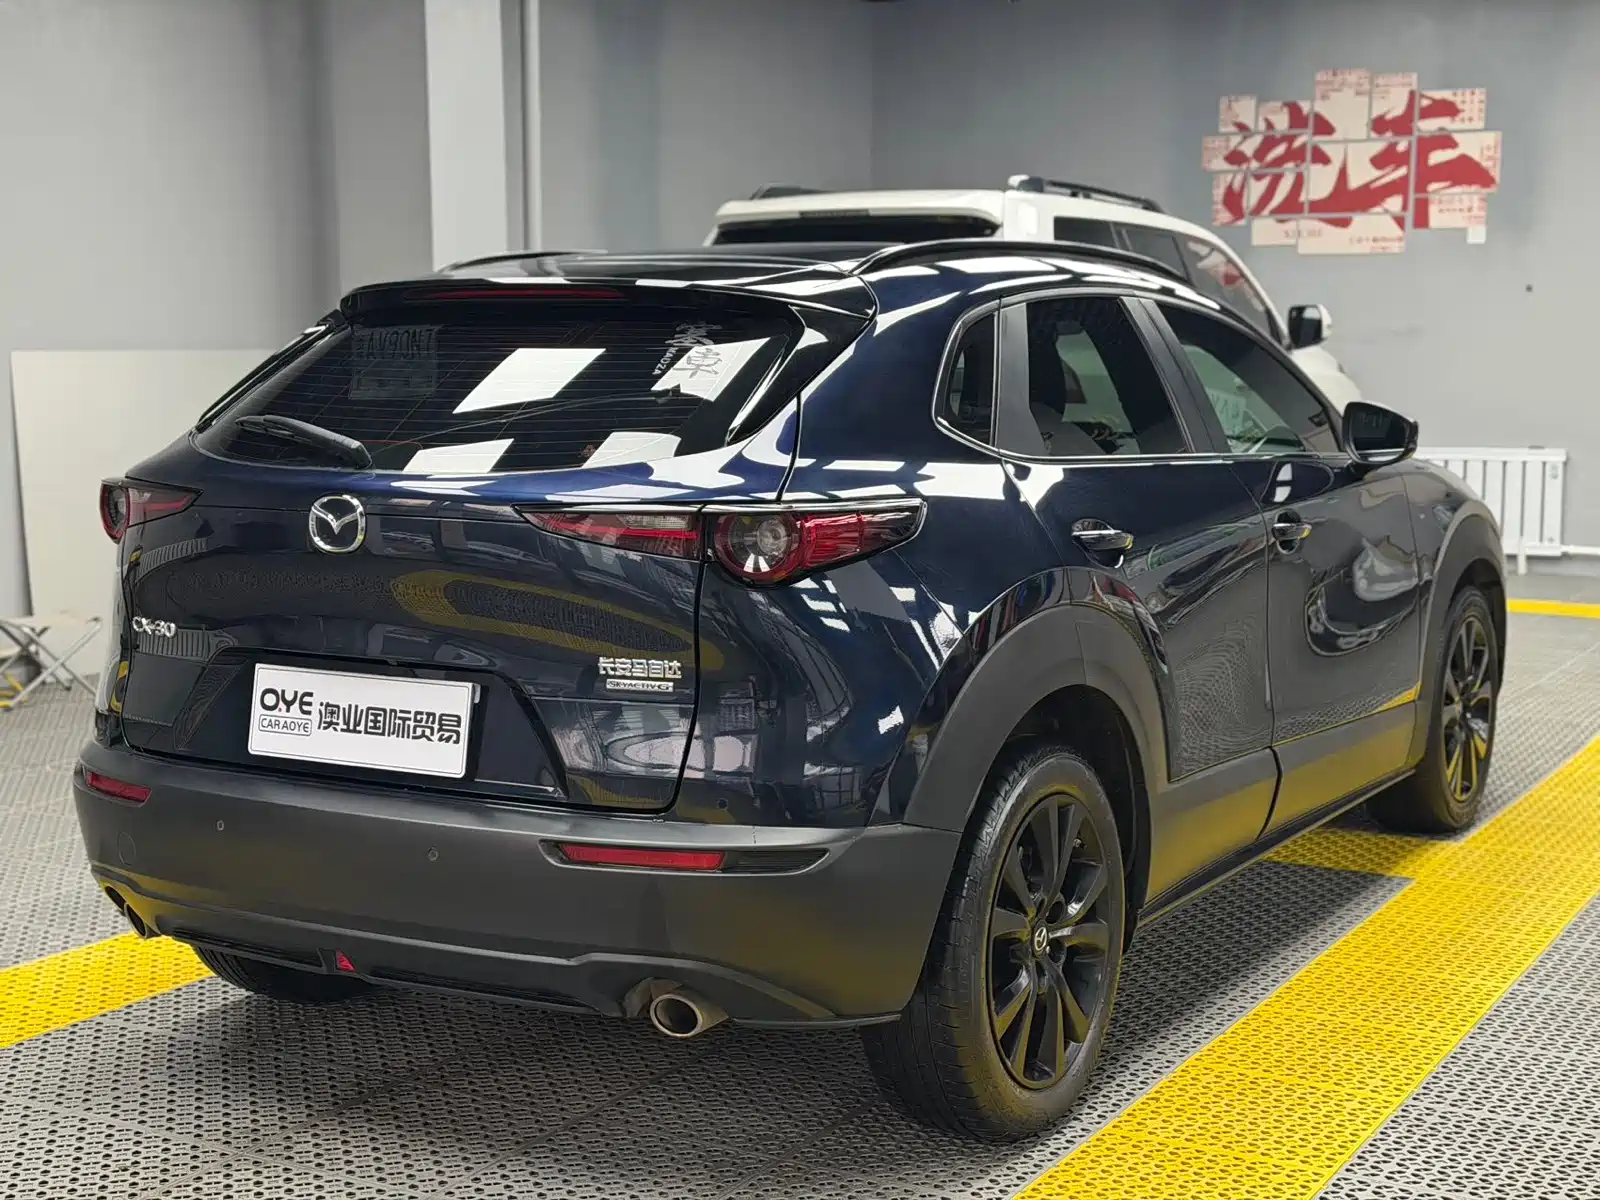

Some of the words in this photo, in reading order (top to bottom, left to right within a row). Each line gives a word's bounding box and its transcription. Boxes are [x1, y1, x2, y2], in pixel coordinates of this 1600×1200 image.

[1221, 89, 1497, 231] 洗车
[132, 616, 177, 639] CX-30
[598, 656, 682, 679] 长安马自达
[259, 687, 314, 716] OYE
[317, 700, 462, 745] 澳业国际贸易
